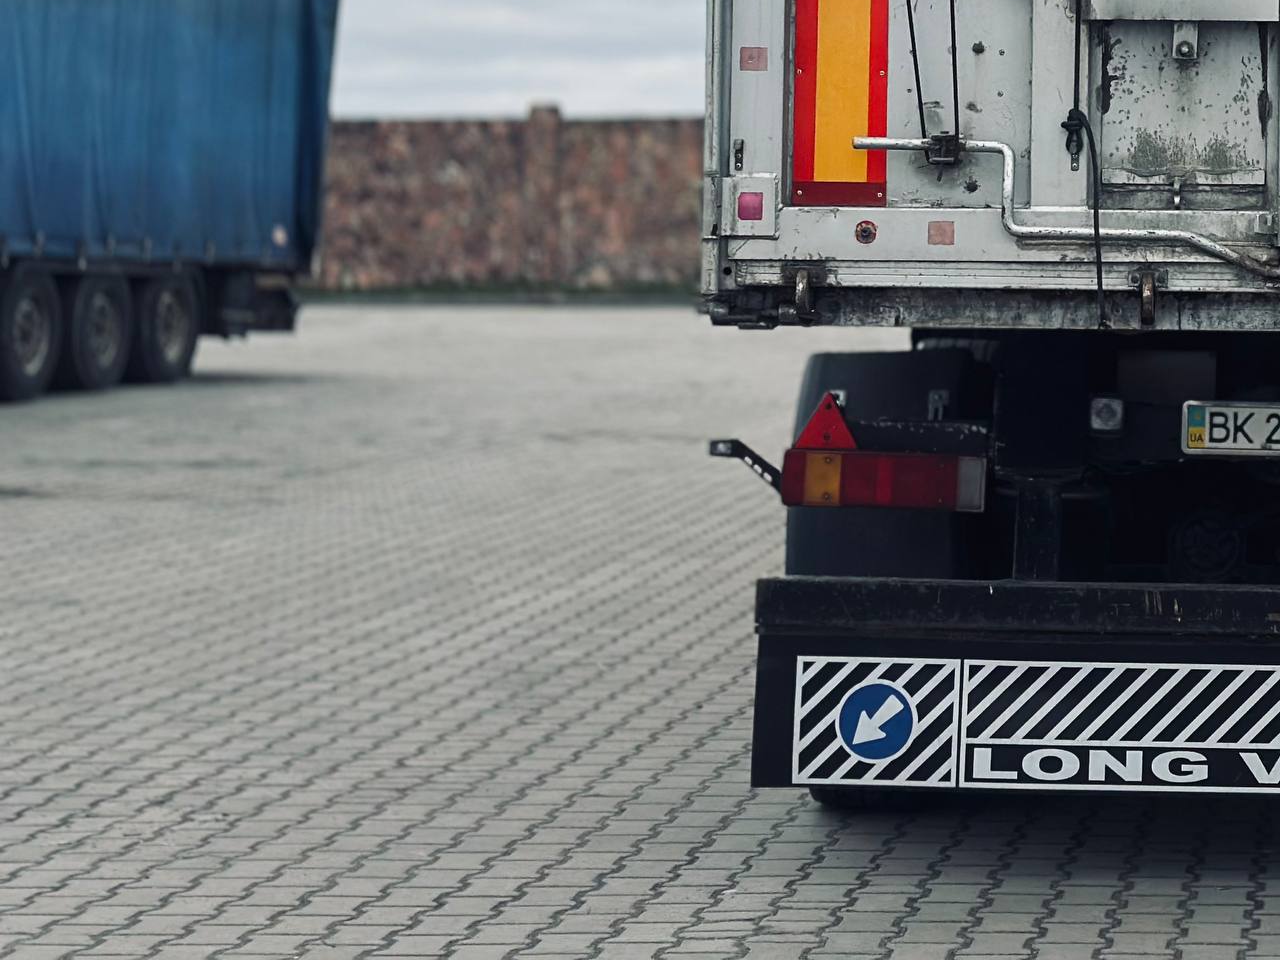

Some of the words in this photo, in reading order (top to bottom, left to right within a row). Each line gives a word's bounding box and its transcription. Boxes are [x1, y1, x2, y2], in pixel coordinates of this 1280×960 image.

[1190, 434, 1204, 443] UA
[1209, 412, 1255, 444] BK
[972, 747, 1209, 783] LONG
